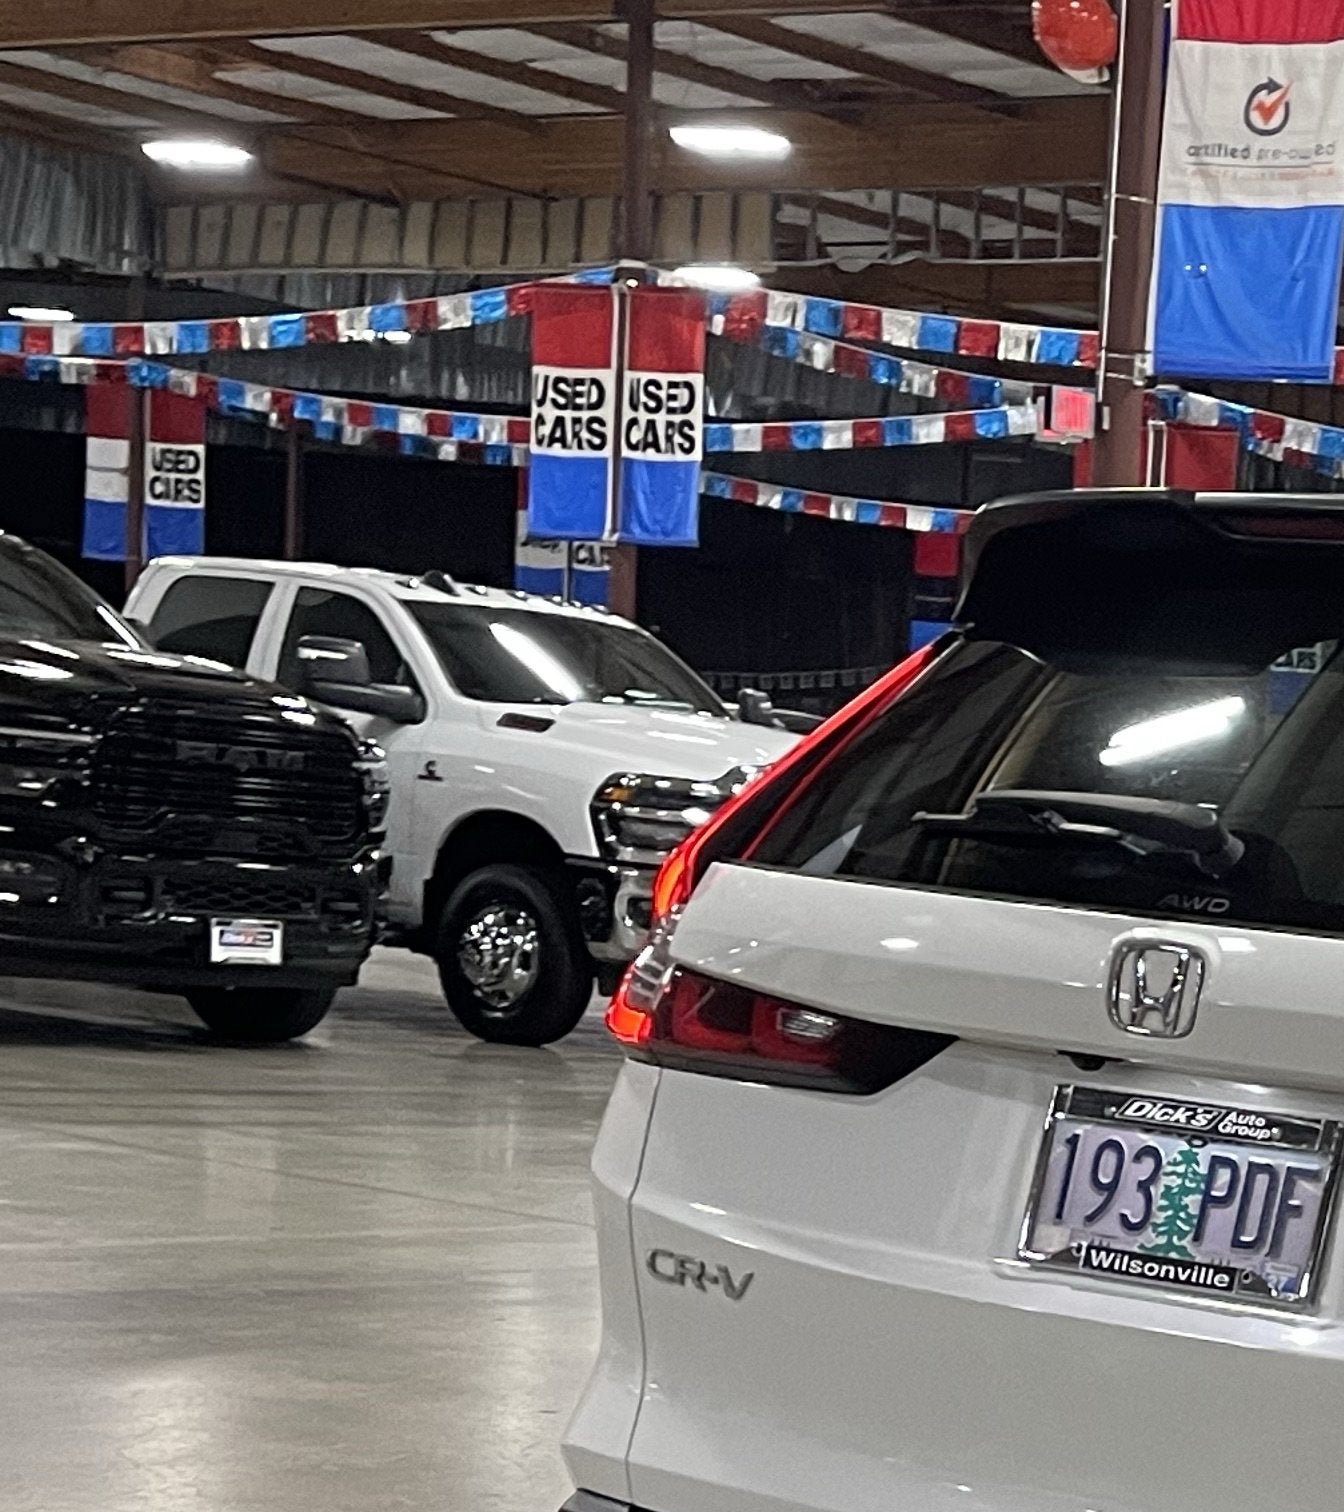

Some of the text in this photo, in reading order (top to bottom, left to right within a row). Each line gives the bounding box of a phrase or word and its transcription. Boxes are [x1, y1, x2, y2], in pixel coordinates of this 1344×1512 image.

[534, 373, 606, 411] USED
[629, 377, 696, 415] USED
[534, 412, 607, 451] CARS
[624, 416, 696, 455] CARS
[1157, 893, 1231, 913] AWD
[1123, 1100, 1215, 1128] Dick's
[1217, 1120, 1271, 1141] Group
[1222, 1110, 1266, 1127] Auto
[1055, 1133, 1322, 1259] 193 PDF
[646, 1249, 755, 1301] CR-V
[1090, 1248, 1230, 1288] Wilsonville
